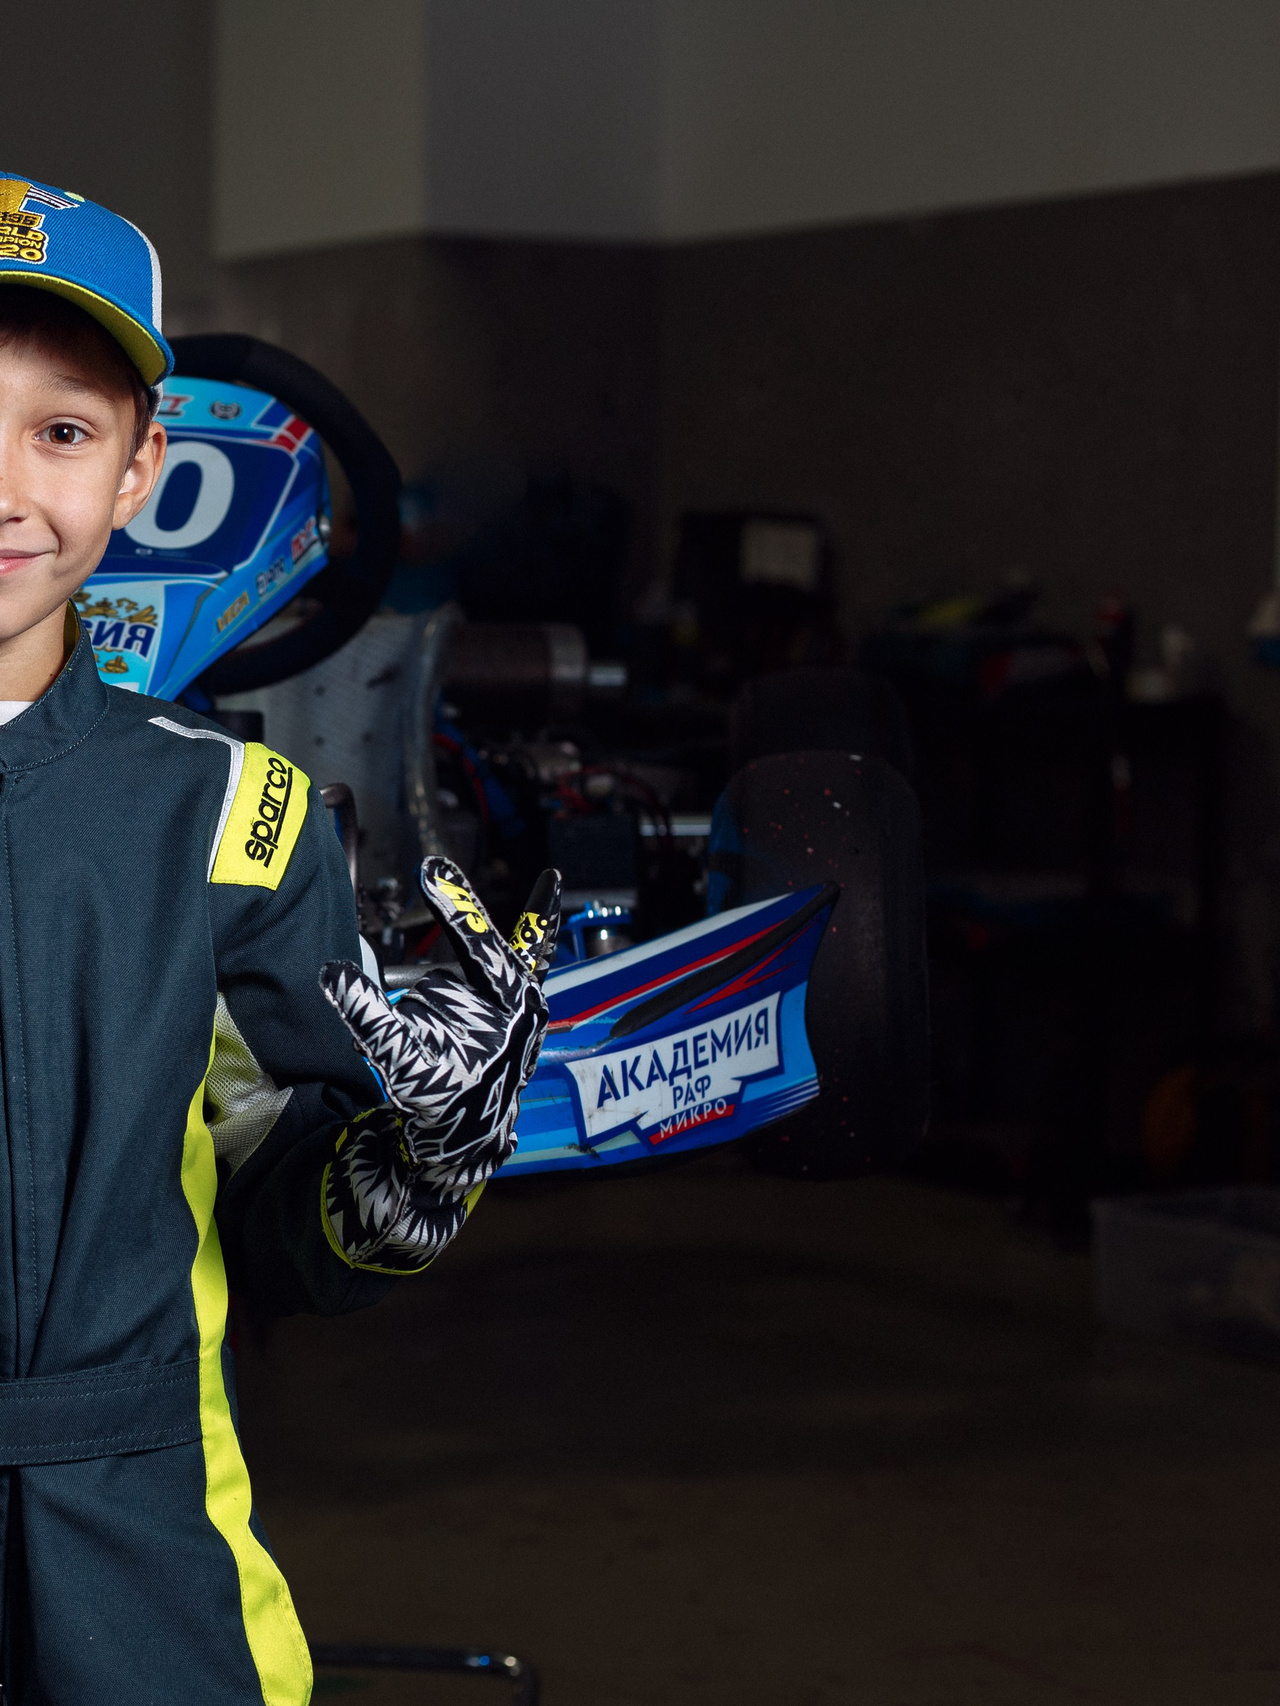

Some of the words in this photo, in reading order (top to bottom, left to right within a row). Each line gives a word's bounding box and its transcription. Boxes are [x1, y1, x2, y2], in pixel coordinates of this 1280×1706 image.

[81, 620, 155, 659] ИЯ
[245, 756, 295, 869] sparco
[596, 1007, 770, 1108] АКАДЕМИЯ
[673, 1075, 712, 1109] РАФ
[658, 1096, 727, 1140] МИКРО
